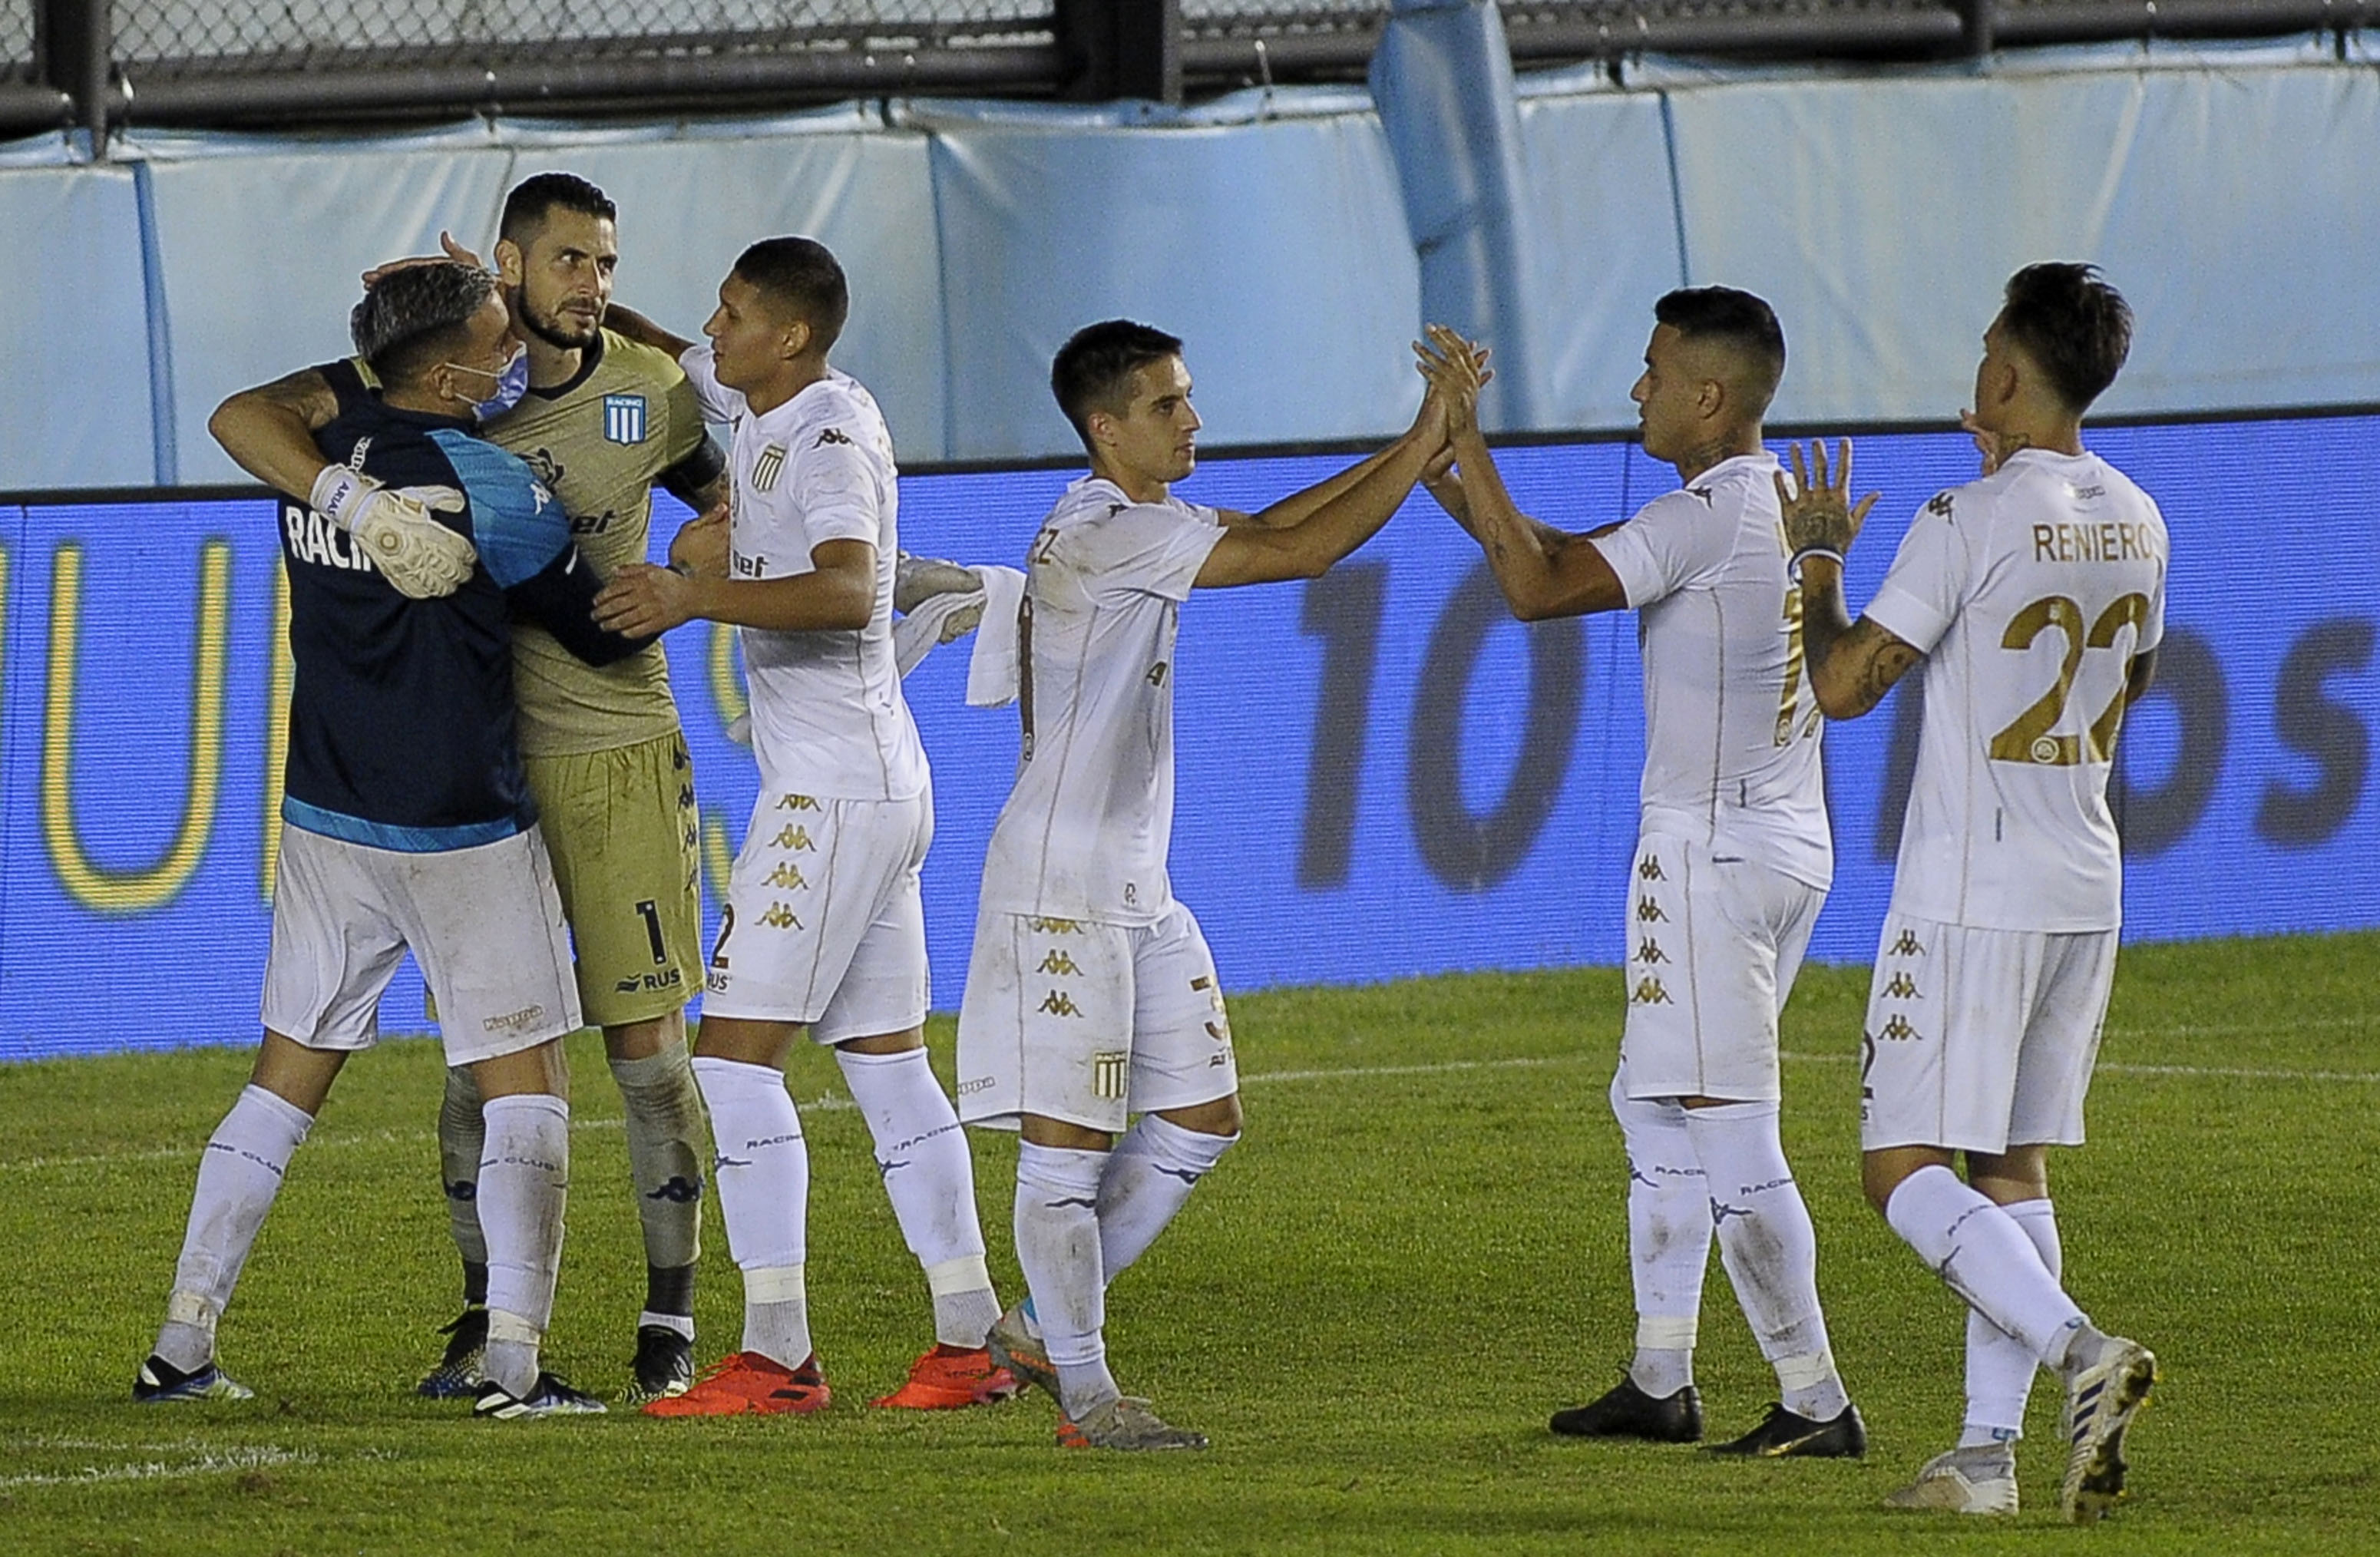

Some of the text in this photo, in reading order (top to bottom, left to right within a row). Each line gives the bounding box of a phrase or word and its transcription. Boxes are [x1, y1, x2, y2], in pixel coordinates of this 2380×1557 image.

[328, 480, 350, 517] ARIAS
[2032, 522, 2153, 563] RENIERO
[1988, 592, 2150, 765] 22
[1296, 557, 1588, 894] 10
[635, 900, 666, 965] 1
[643, 968, 680, 989] RUS
